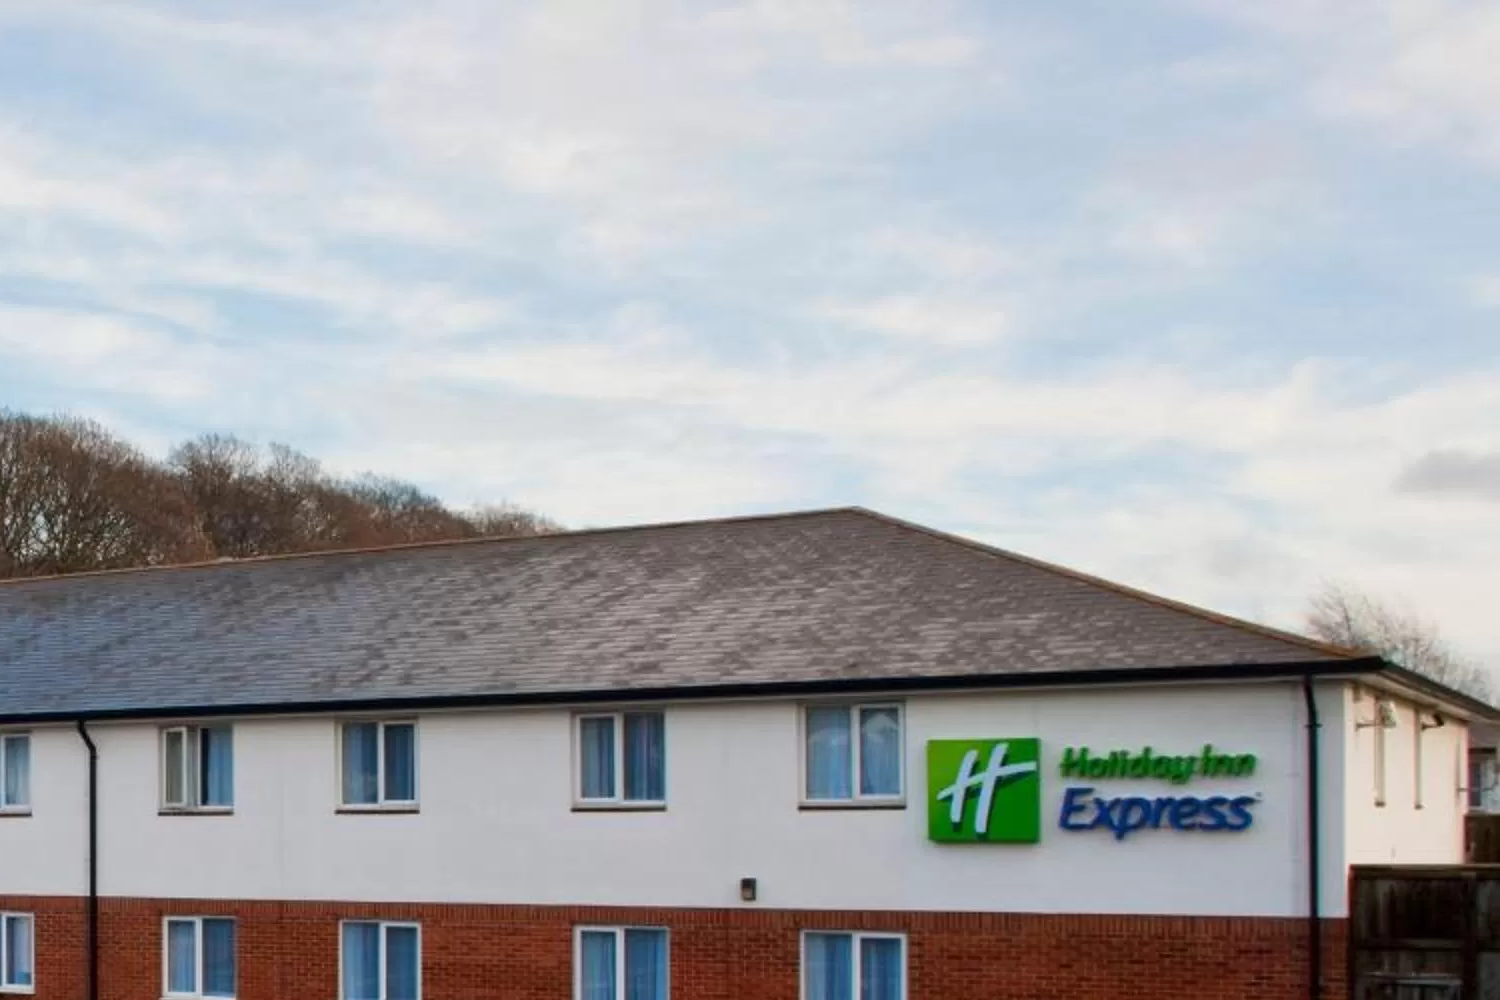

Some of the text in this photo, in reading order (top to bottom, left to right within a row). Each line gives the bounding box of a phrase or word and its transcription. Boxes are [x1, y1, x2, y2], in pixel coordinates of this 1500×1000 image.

[1060, 744, 1257, 784] Holiday Inn
[1059, 787, 1258, 840] Express
